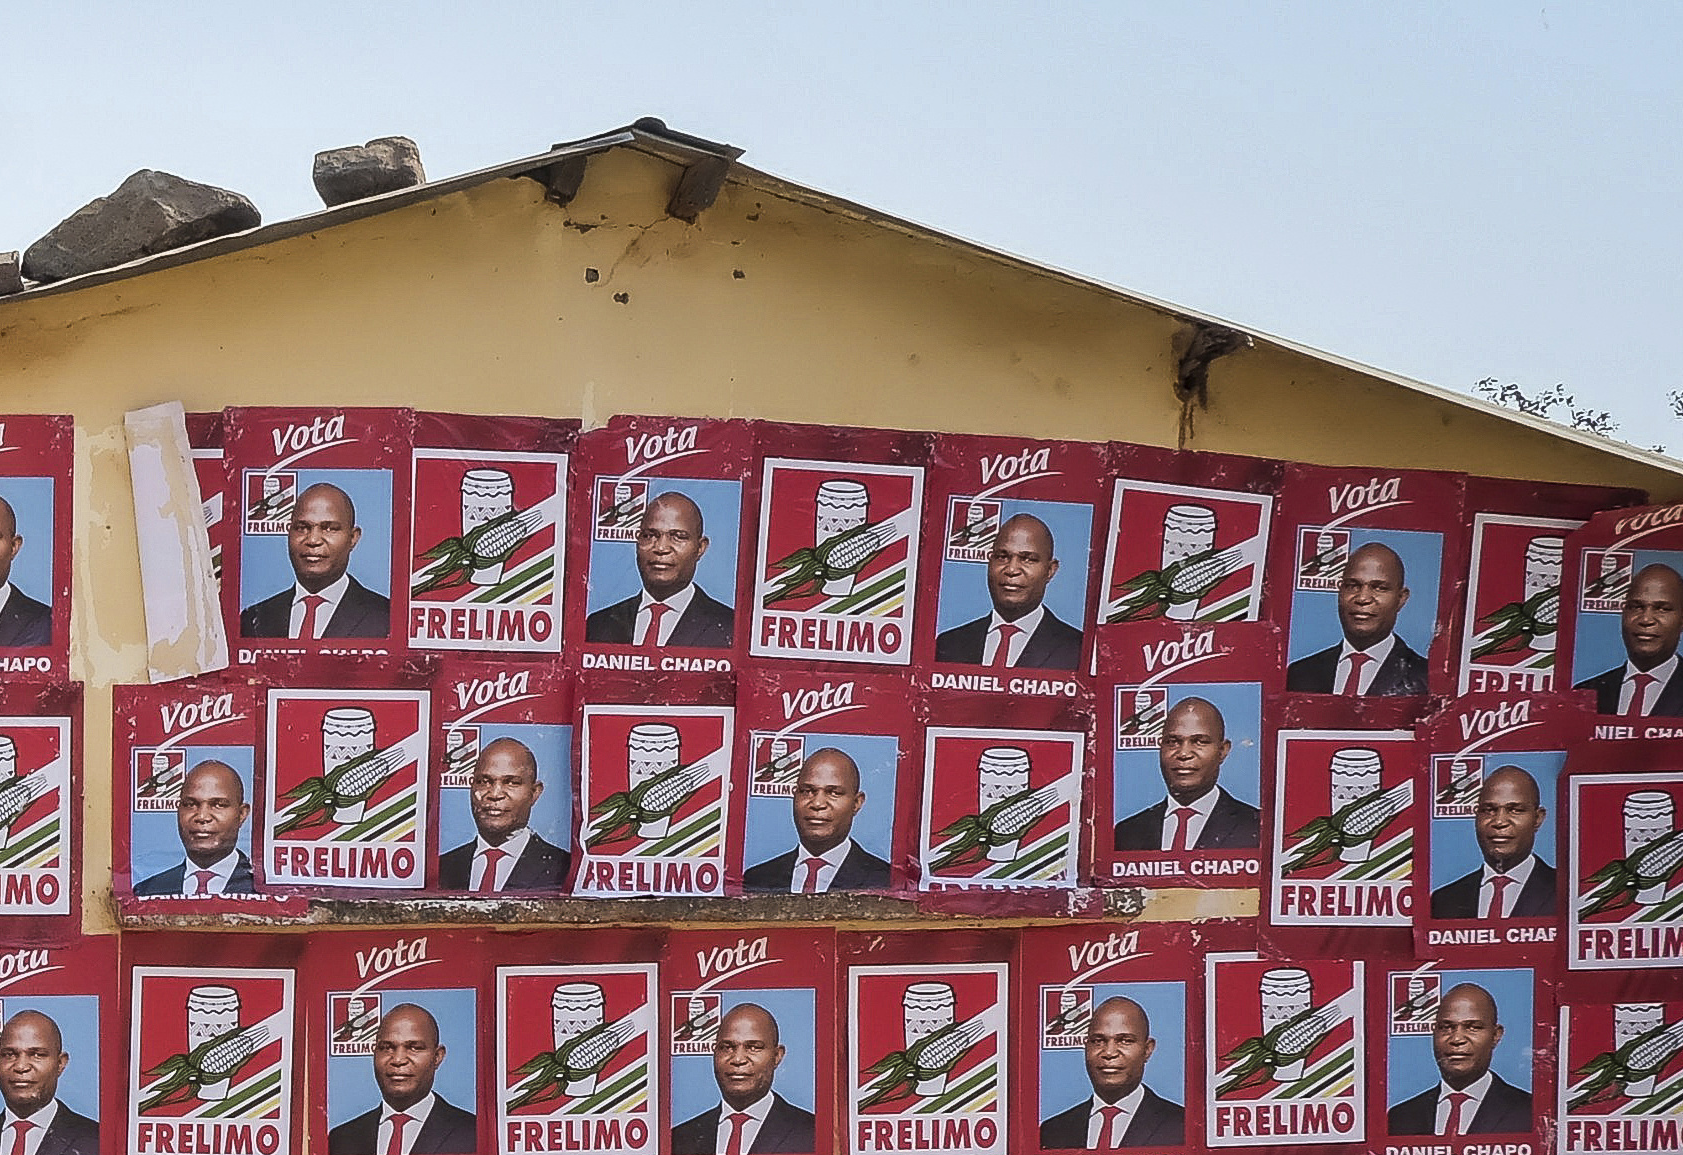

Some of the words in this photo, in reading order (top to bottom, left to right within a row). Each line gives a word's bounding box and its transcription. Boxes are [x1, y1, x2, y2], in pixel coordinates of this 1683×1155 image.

[273, 415, 344, 455] Vota
[626, 426, 697, 463] Vota
[981, 448, 1050, 484] Vota
[1329, 476, 1402, 513] Vota
[411, 607, 552, 641] FRELIMO
[761, 616, 901, 654] FRELIMO
[583, 654, 656, 670] DANIEL
[661, 658, 730, 671] CHAPO
[1143, 630, 1214, 671] Vota
[454, 671, 529, 709] Vota
[783, 682, 854, 719] Vota
[932, 674, 1004, 691] DANIEL
[1010, 679, 1076, 696] CHAPO
[161, 694, 232, 733] Vota
[1460, 700, 1530, 740] Vota
[274, 847, 414, 878] FRELIMO
[1113, 861, 1185, 876] DANIEL
[1191, 860, 1259, 874] CHAPO
[1281, 886, 1413, 916] FRELIMO
[1069, 931, 1139, 971] Vota
[1429, 930, 1500, 944] DANIEL
[1507, 928, 1556, 942] CHAP
[1578, 927, 1683, 960] FRELIM
[356, 937, 427, 978] Vota
[697, 937, 767, 977] Vota
[507, 1119, 648, 1152] FRELIMO
[858, 1118, 997, 1151] FRELIMO
[1217, 1102, 1354, 1137] FRELIMO
[1567, 1120, 1683, 1151] FRELIM
[138, 1123, 279, 1155] FRELIMO
